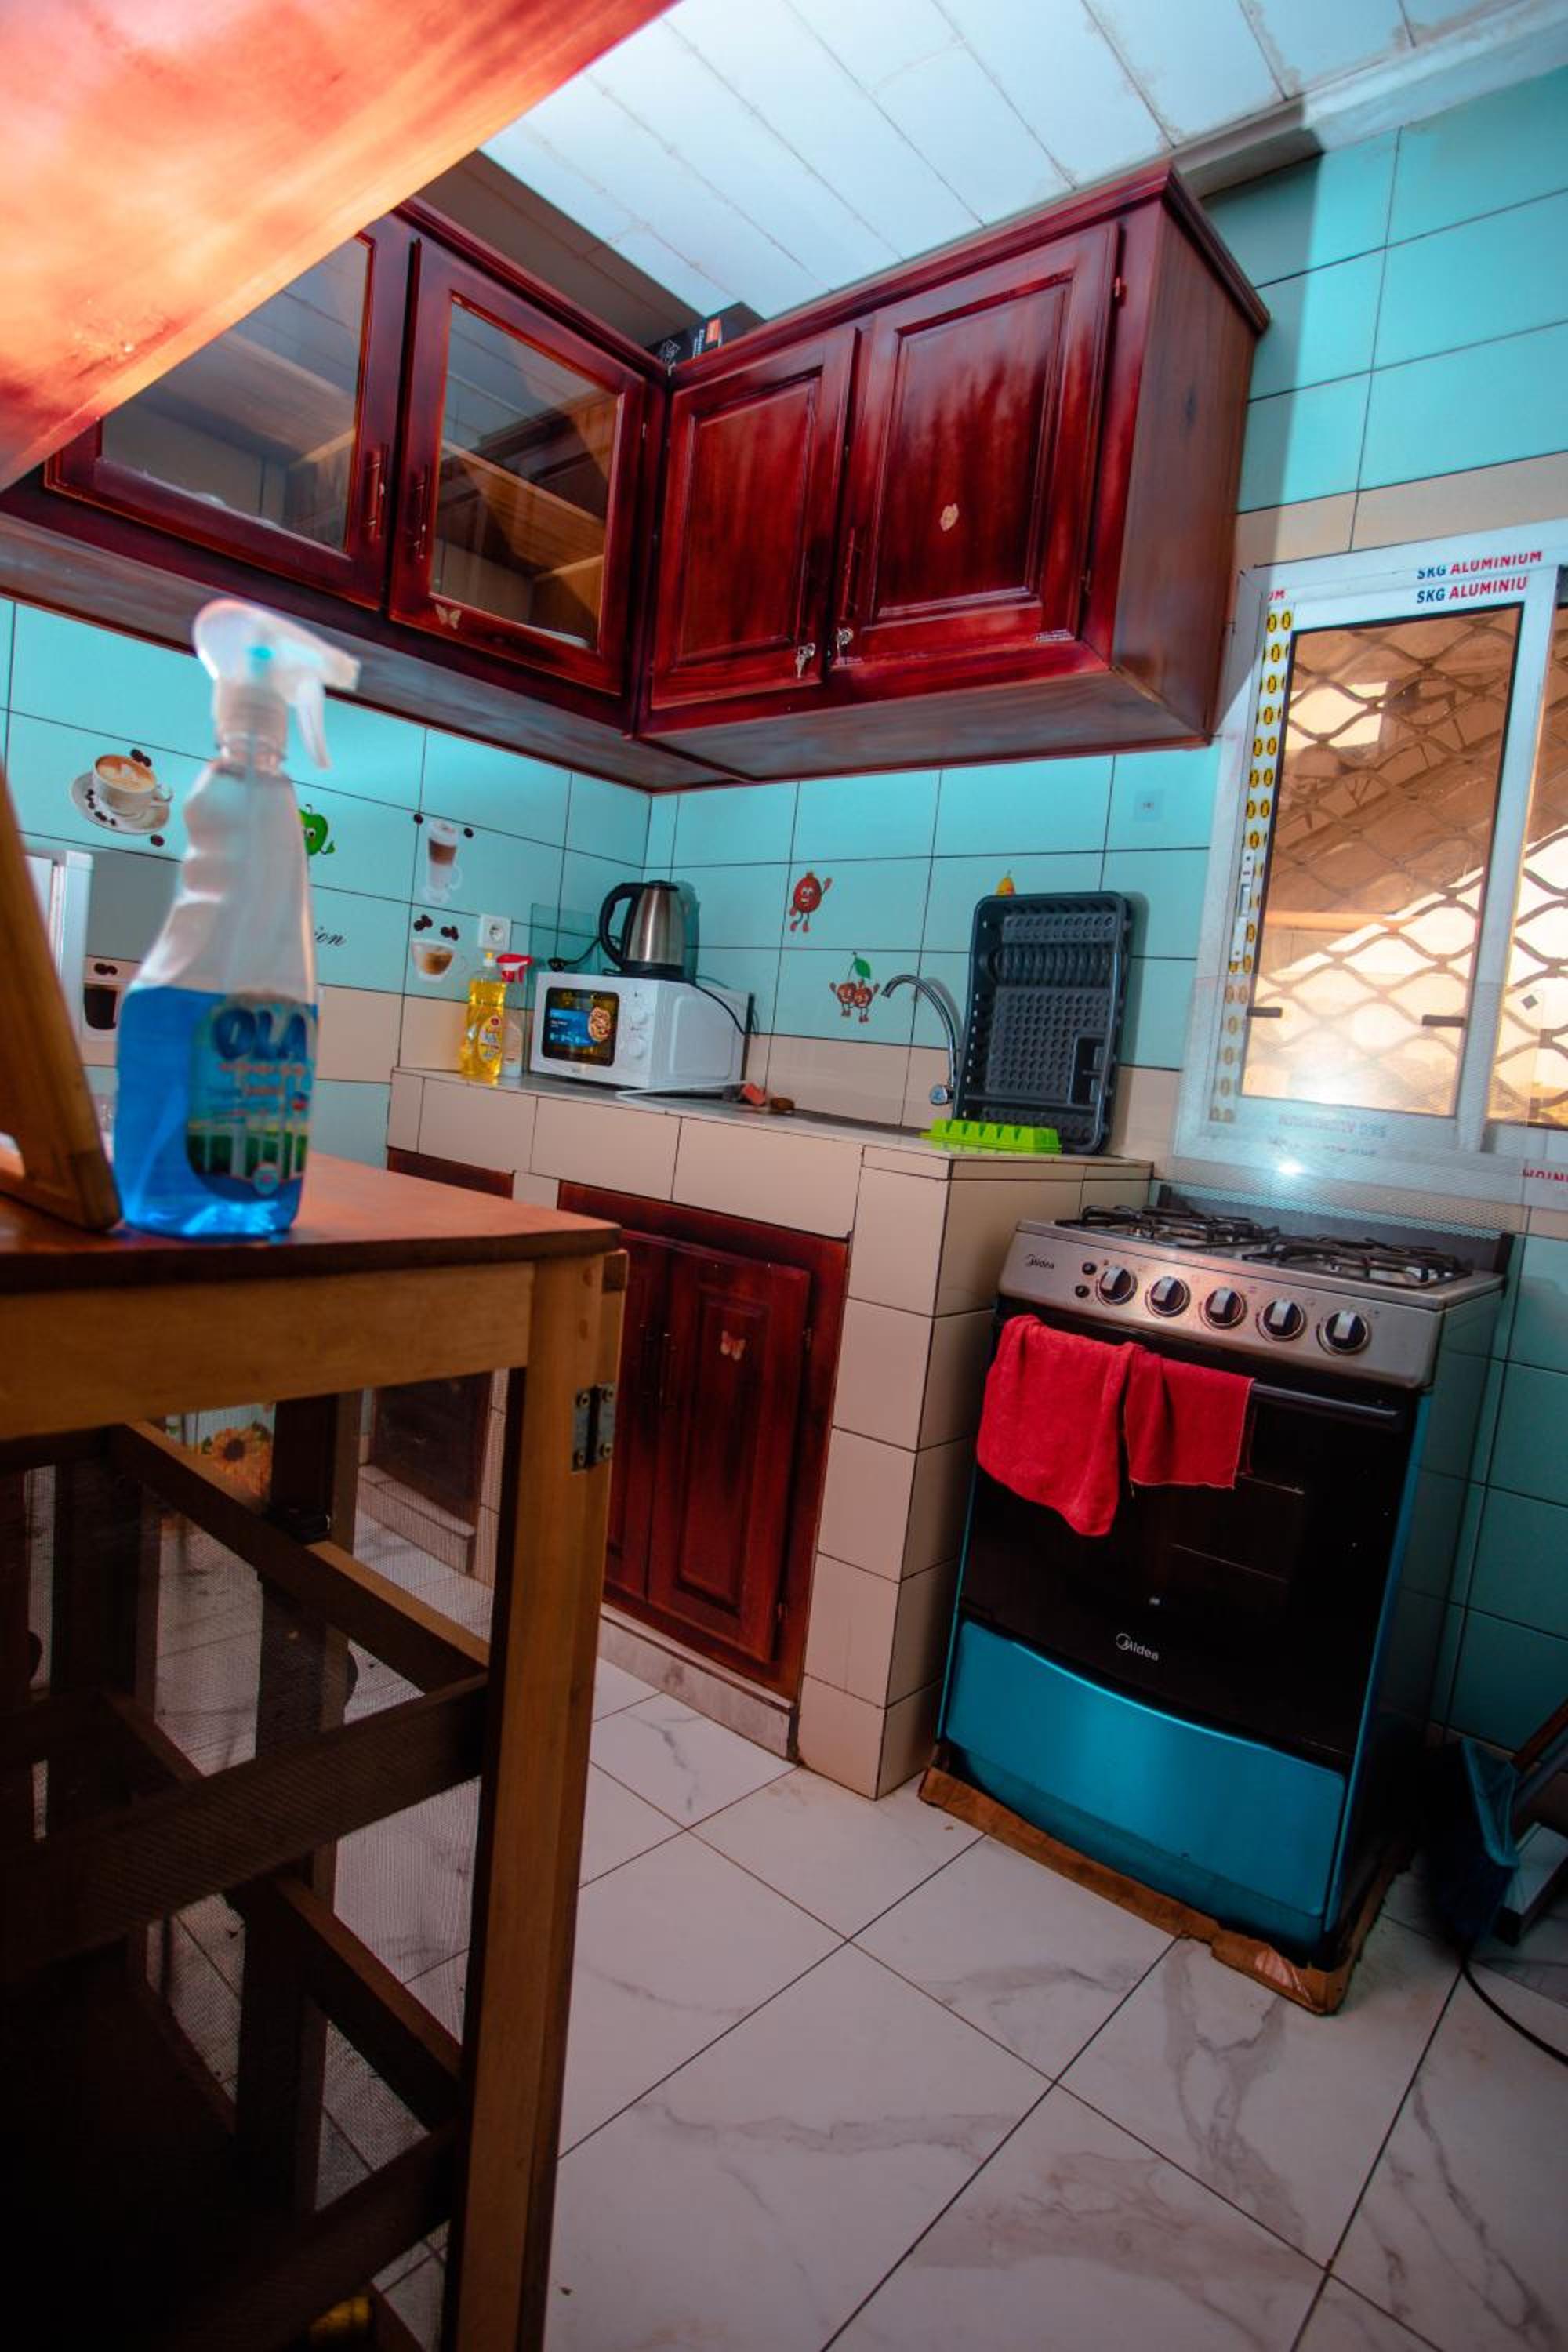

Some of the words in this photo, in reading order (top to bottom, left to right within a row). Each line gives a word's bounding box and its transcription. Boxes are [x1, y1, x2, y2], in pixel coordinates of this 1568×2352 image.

[1417, 565, 1446, 580] SKG
[1450, 550, 1543, 575] ALUMINIUM
[1417, 588, 1445, 604] SKG
[1449, 576, 1529, 601] ALUMINIU
[213, 1007, 307, 1062] OLA
[1025, 1254, 1054, 1269] Midea
[1116, 1633, 1160, 1662] Midea
